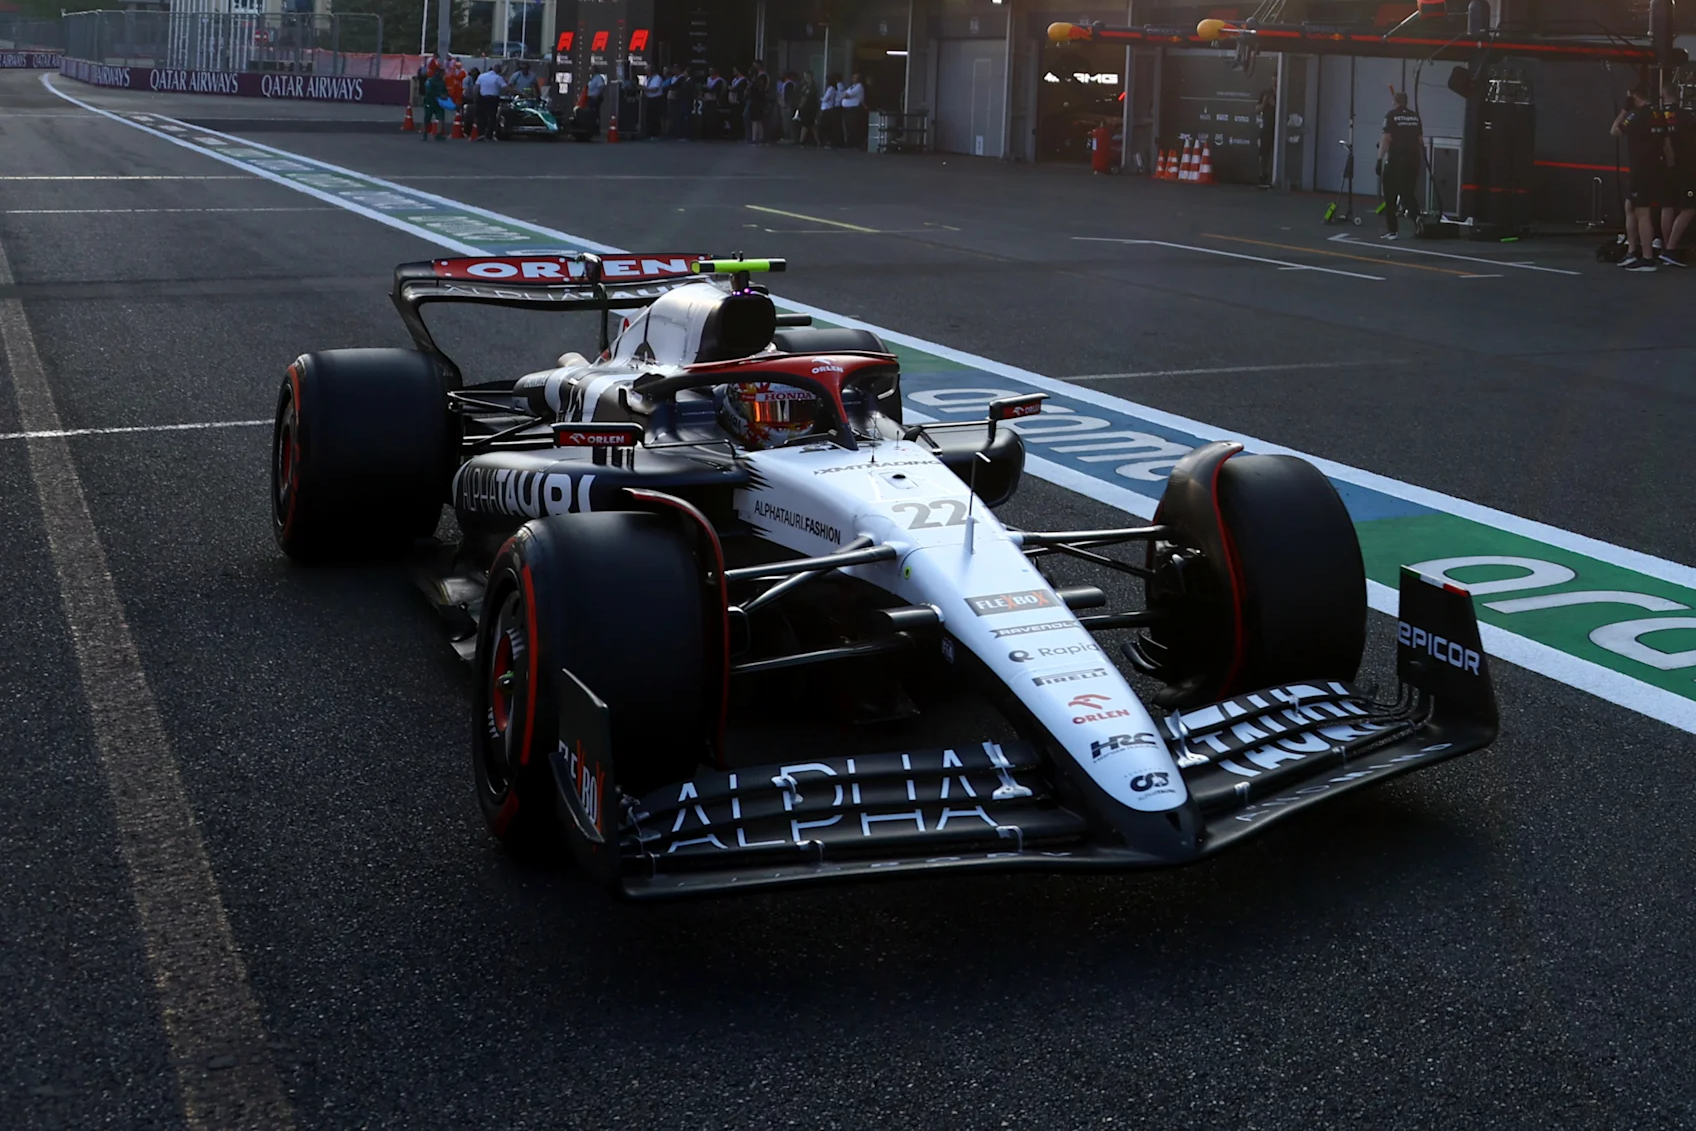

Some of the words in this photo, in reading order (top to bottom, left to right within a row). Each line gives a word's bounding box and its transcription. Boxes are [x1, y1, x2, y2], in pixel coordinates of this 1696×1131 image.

[150, 70, 188, 91] QATAR
[189, 72, 239, 94] AIRWAYS
[261, 75, 304, 98] QATAR
[306, 77, 363, 101] AIRWAYS
[466, 258, 688, 279] ORLEN
[811, 364, 843, 375] ORLEN
[764, 391, 813, 401] HONDA
[587, 432, 625, 444] ORLEN
[892, 499, 979, 530] 22
[975, 590, 1050, 611] FLEXBOX
[999, 621, 1073, 636] RAVENOL
[1032, 668, 1109, 687] PIRELLI
[1072, 709, 1131, 725] ORLEN
[1090, 732, 1157, 759] HRC
